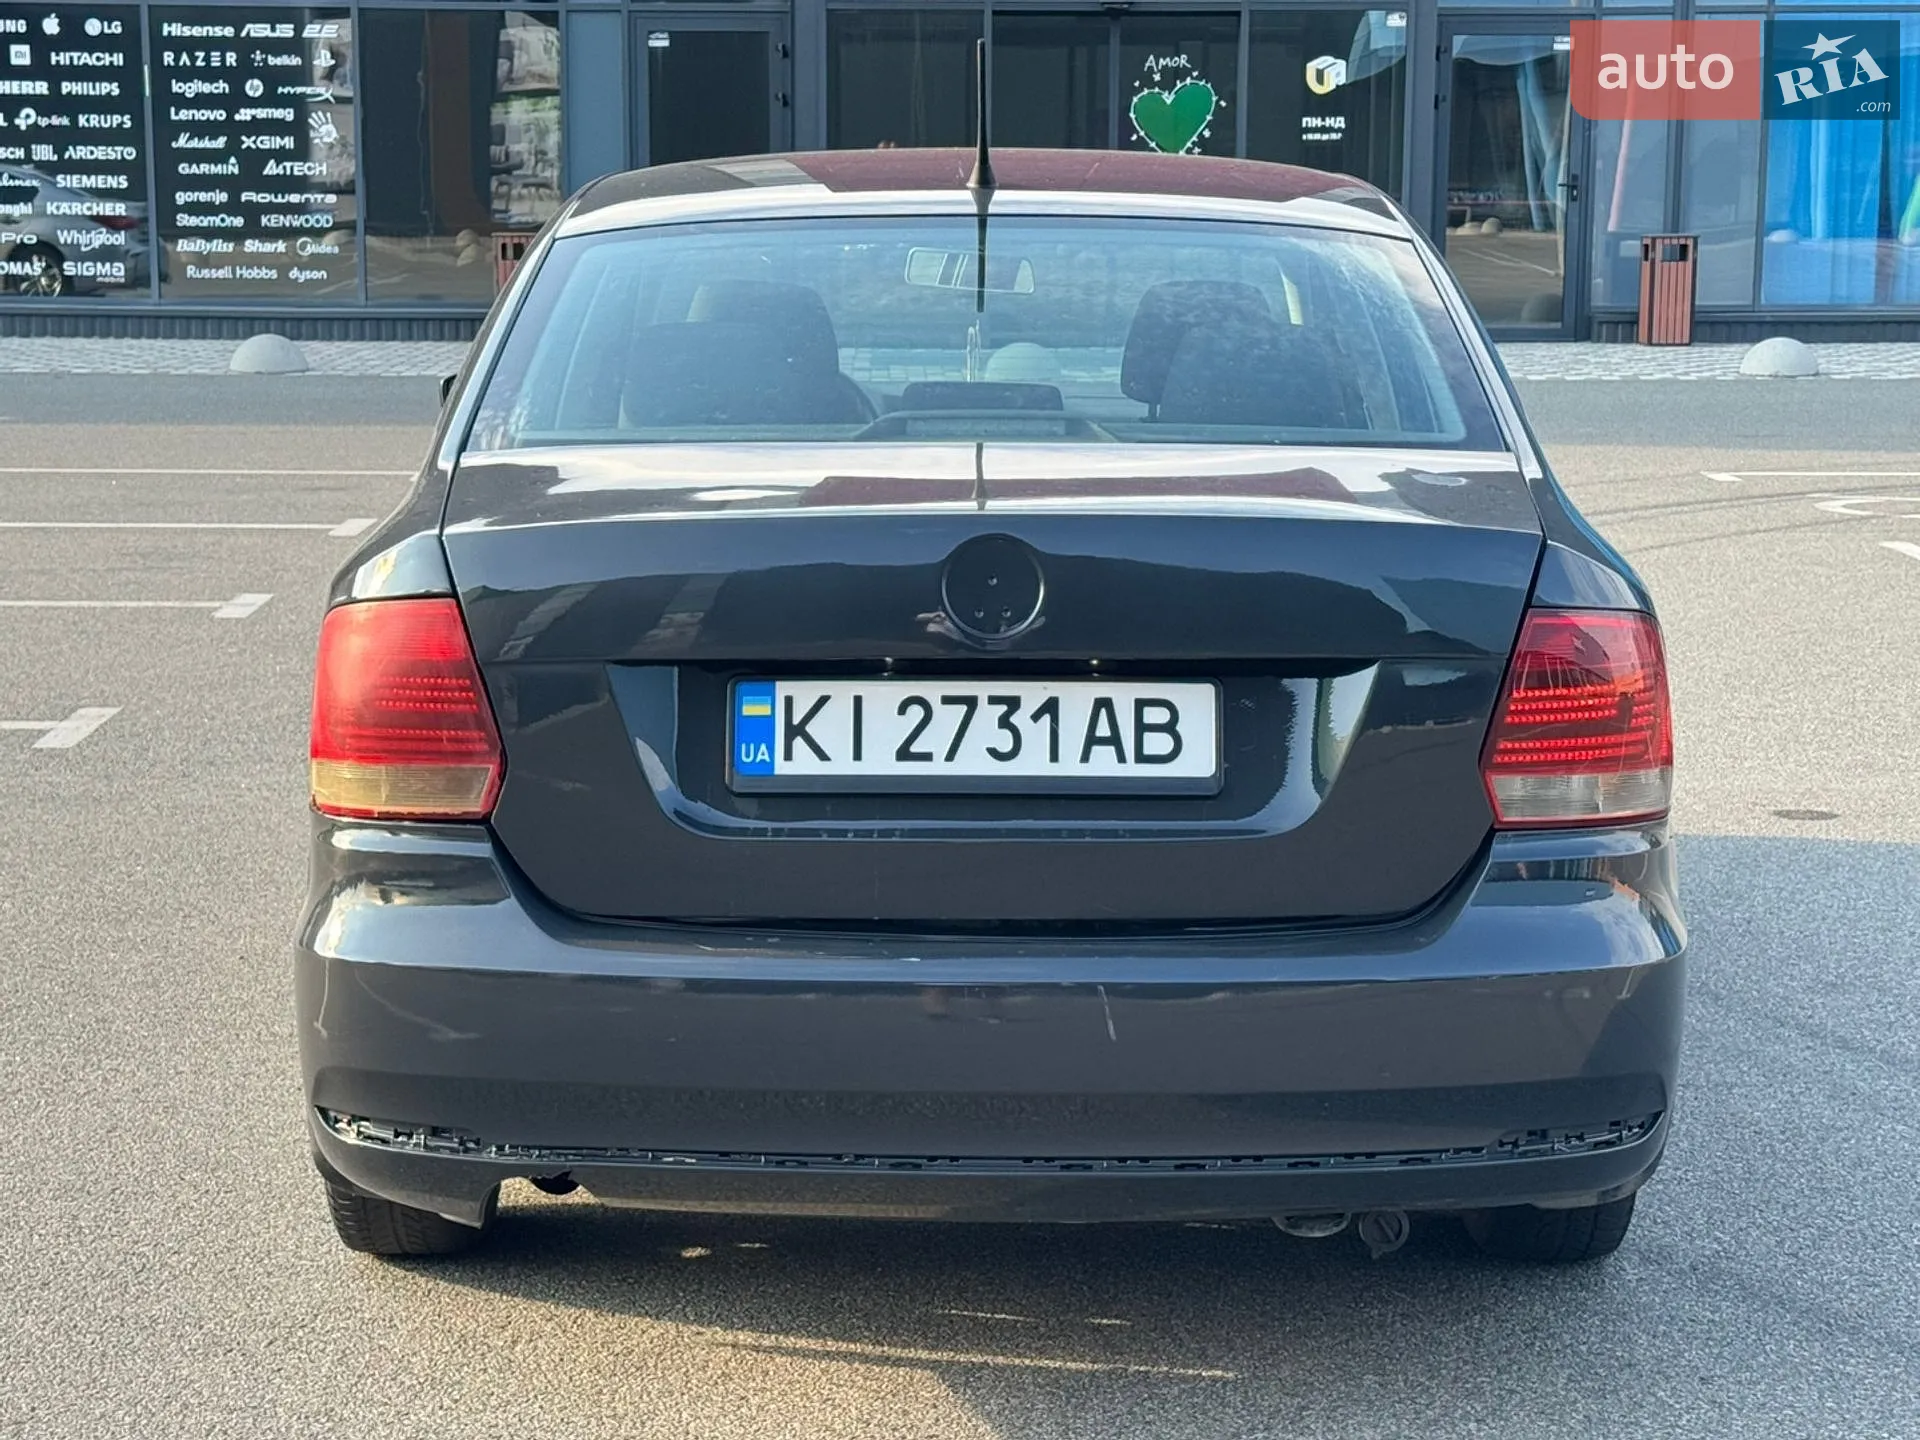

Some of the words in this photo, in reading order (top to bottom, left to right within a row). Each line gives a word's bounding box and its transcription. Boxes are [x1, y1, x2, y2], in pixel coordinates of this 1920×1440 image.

[103, 21, 123, 34] LG
[162, 22, 235, 37] Hisense
[240, 23, 295, 38] ASUS
[50, 52, 124, 66] HITACHI
[163, 51, 237, 67] RAZER
[267, 54, 302, 66] belkin
[61, 81, 120, 96] PHILIPS
[171, 78, 229, 98] logitech
[37, 114, 71, 128] tp-link
[78, 113, 132, 128] KRUPS
[170, 106, 227, 121] Lenovo
[256, 107, 295, 121] smeg
[1302, 116, 1346, 129] ПН-НД
[171, 132, 228, 149] Marshall
[240, 135, 295, 149] XGIMI
[64, 145, 136, 160] ARDESTO
[178, 156, 239, 175] GARMIN
[56, 174, 128, 189] SIEMENS
[175, 189, 228, 205] gorenje
[176, 213, 244, 228] SteamOne
[261, 214, 333, 228] KENWOOD
[1, 231, 38, 245] Pro
[56, 227, 125, 252] Whirlpool
[176, 238, 235, 255] BaByliss
[243, 239, 288, 253] Shark
[186, 265, 233, 279] Russell
[236, 265, 278, 279] Hobbs
[289, 267, 328, 283] dyson
[782, 694, 863, 762] KI
[894, 695, 1060, 763] 2731
[1078, 696, 1184, 765] AB
[741, 742, 771, 763] UA
